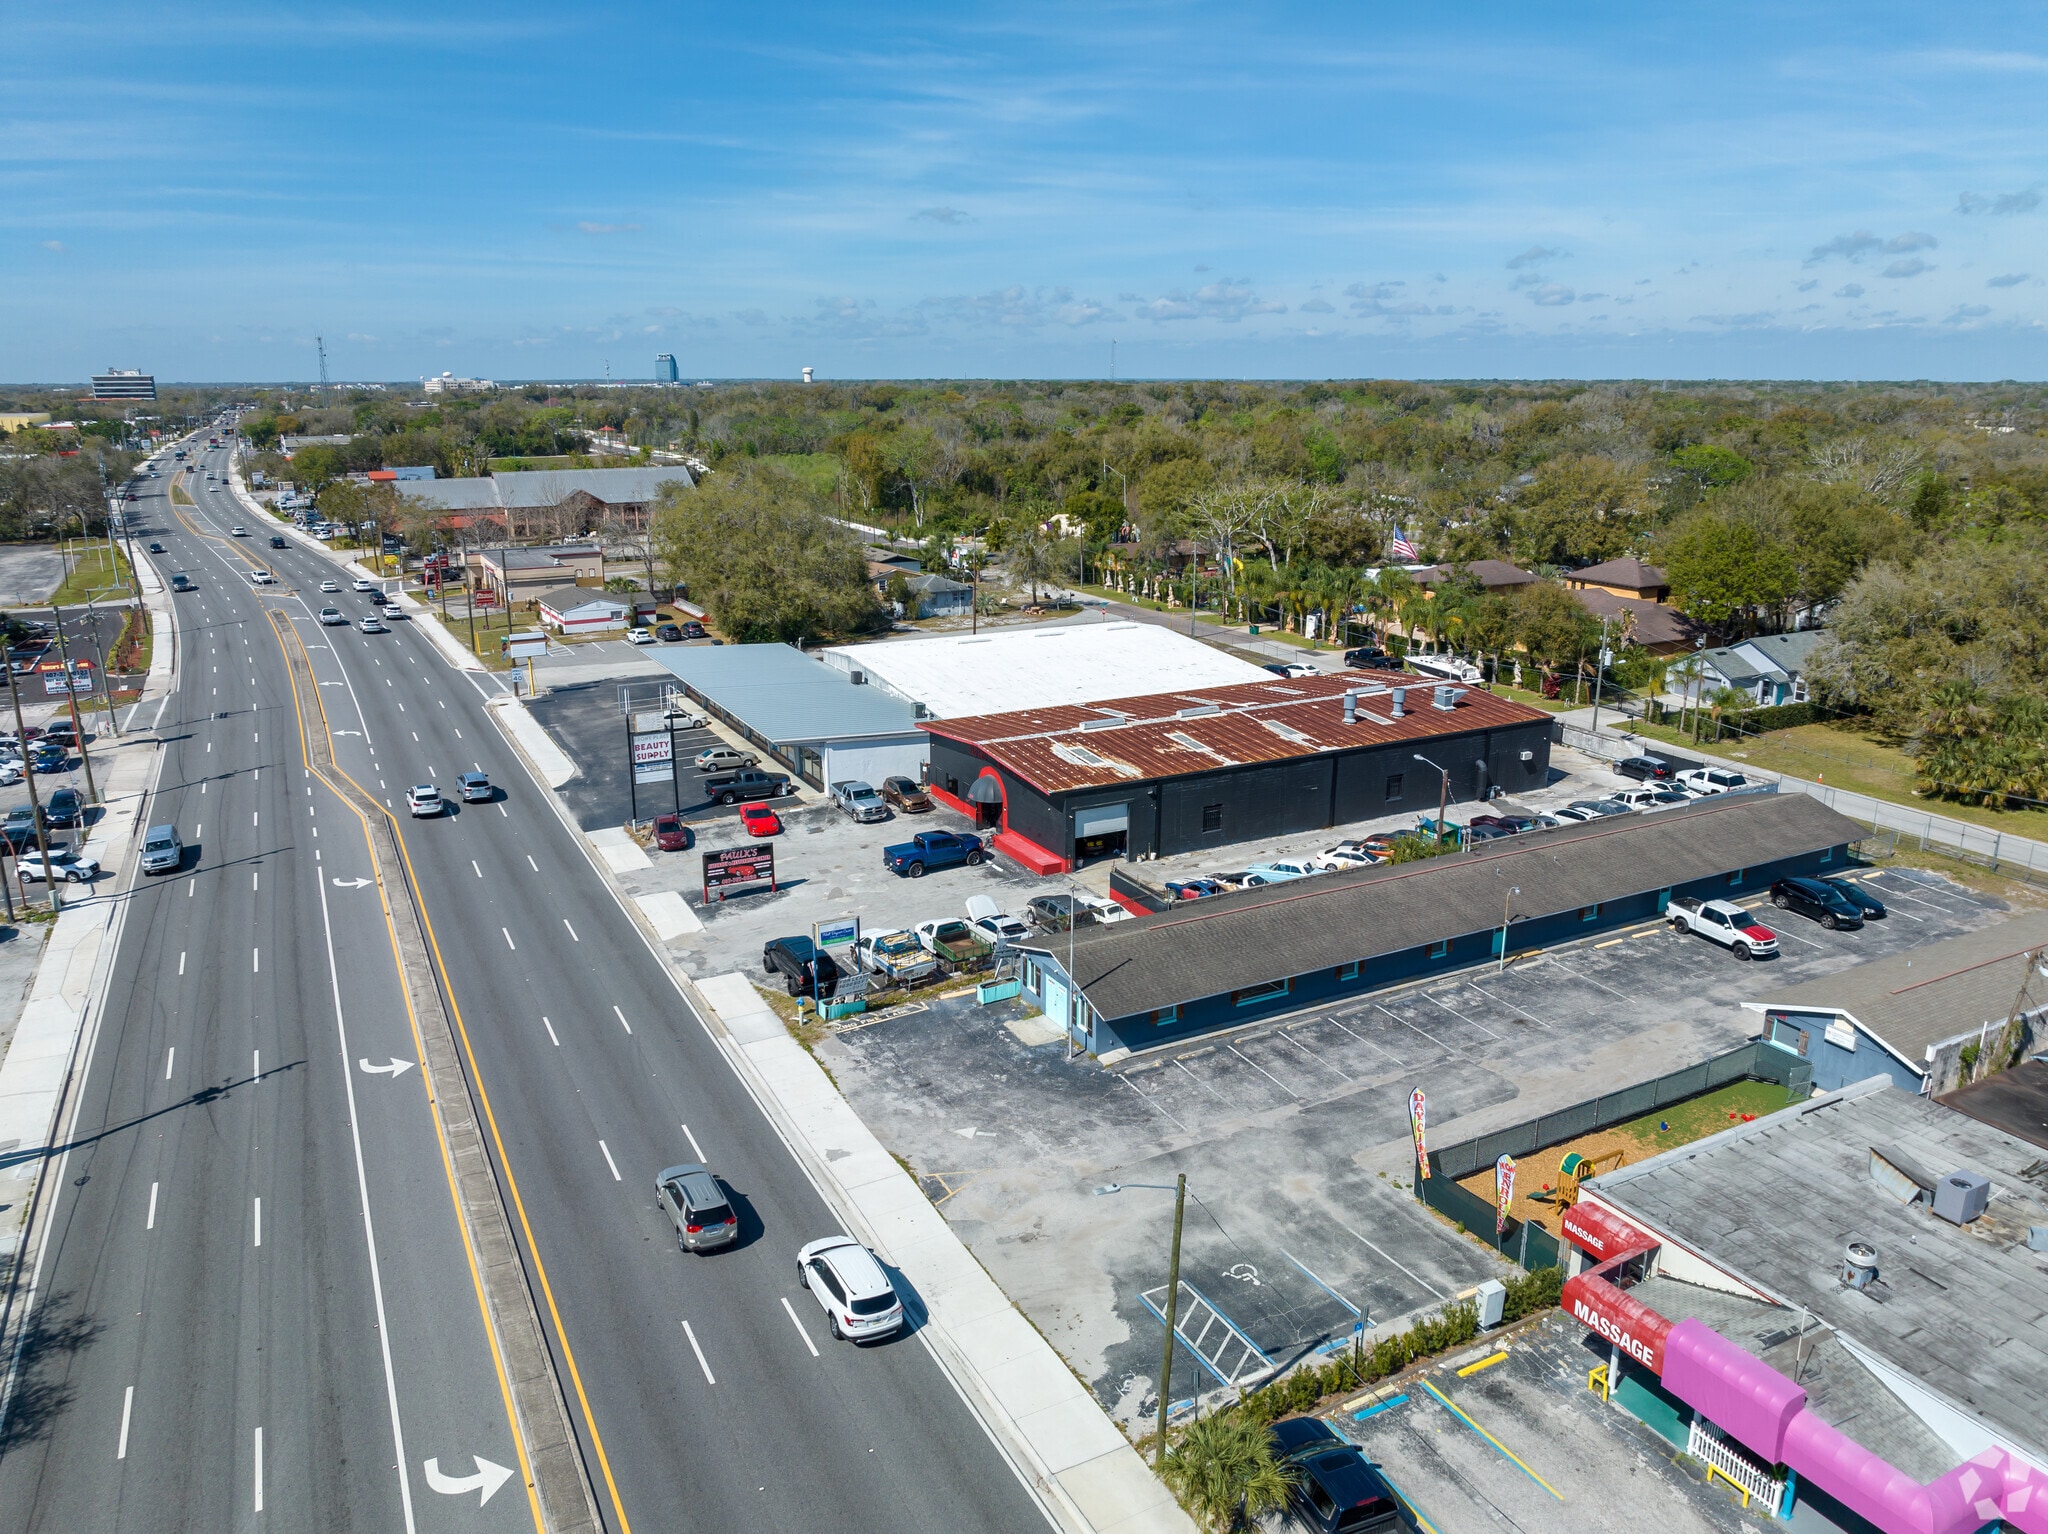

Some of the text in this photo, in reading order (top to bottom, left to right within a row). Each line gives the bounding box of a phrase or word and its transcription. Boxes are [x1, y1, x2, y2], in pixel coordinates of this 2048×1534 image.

[634, 741, 669, 752] BEAUTY
[636, 750, 669, 761] SUPPLY
[1564, 1219, 1604, 1251] MASSAGE
[1573, 1298, 1654, 1367] MASSAGE
